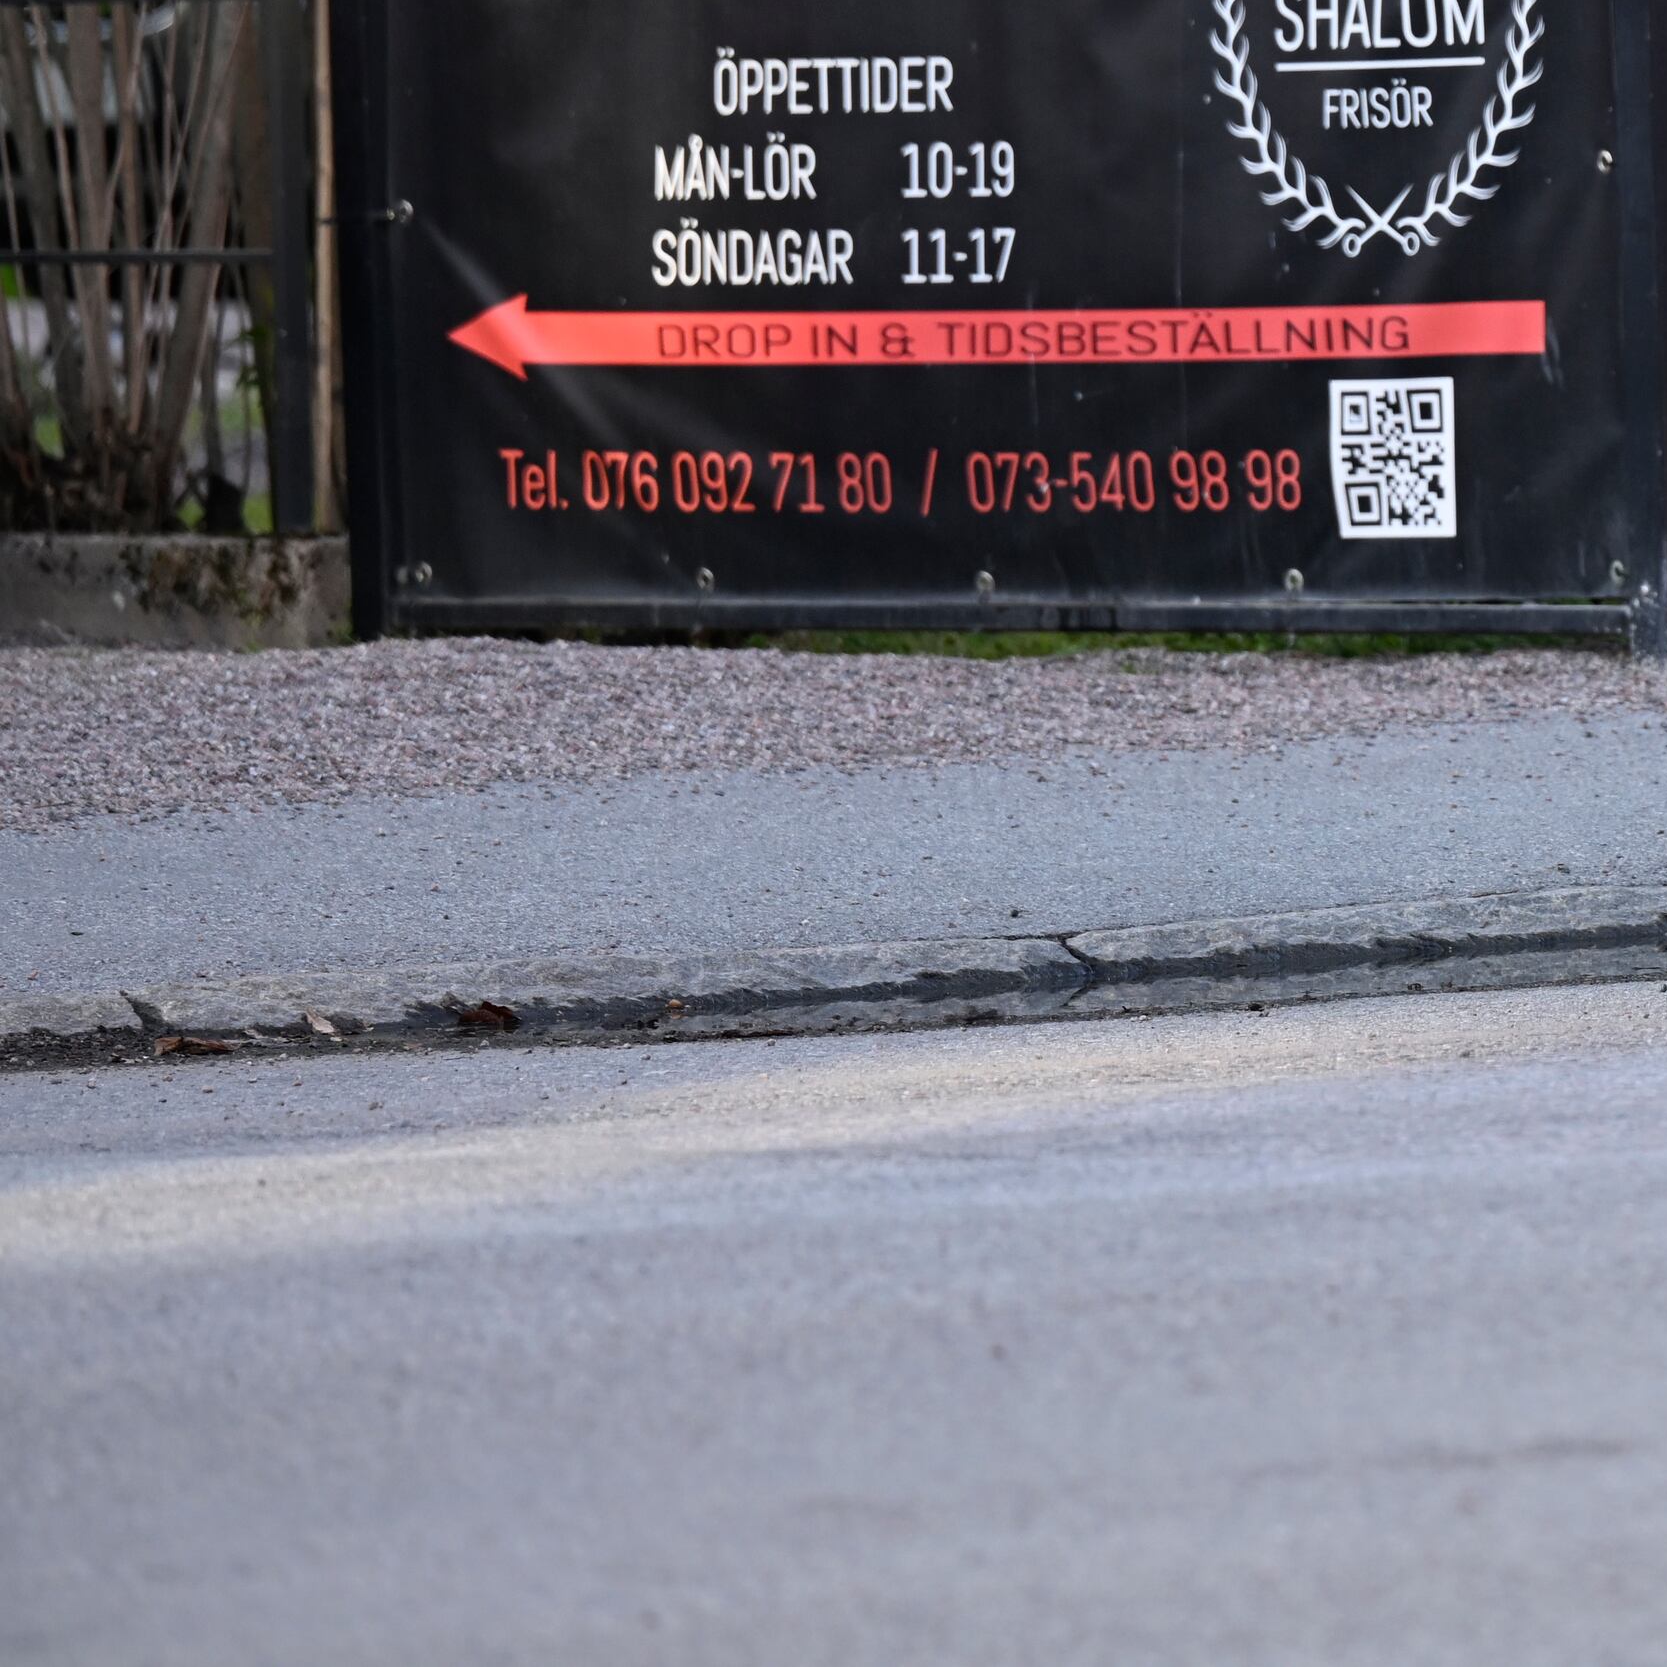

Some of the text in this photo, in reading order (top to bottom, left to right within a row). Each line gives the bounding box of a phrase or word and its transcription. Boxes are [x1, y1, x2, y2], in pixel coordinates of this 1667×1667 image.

[712, 44, 954, 116] ÖPPETTIDER
[1322, 77, 1435, 130] FRISÖR
[653, 130, 1016, 202] MÅN-LÖR 10-19
[651, 217, 1017, 287] SÖNDAGAR 11-17
[655, 312, 1412, 358] DROP IN & TIDSBESTÄLLNING
[499, 448, 569, 511] Tel.
[582, 451, 660, 512] 076
[672, 451, 755, 513] 092
[770, 452, 822, 513] 71
[838, 452, 893, 513] 80
[967, 450, 1156, 513] 073-540
[1170, 450, 1230, 512] 98
[1246, 449, 1302, 511] 98
